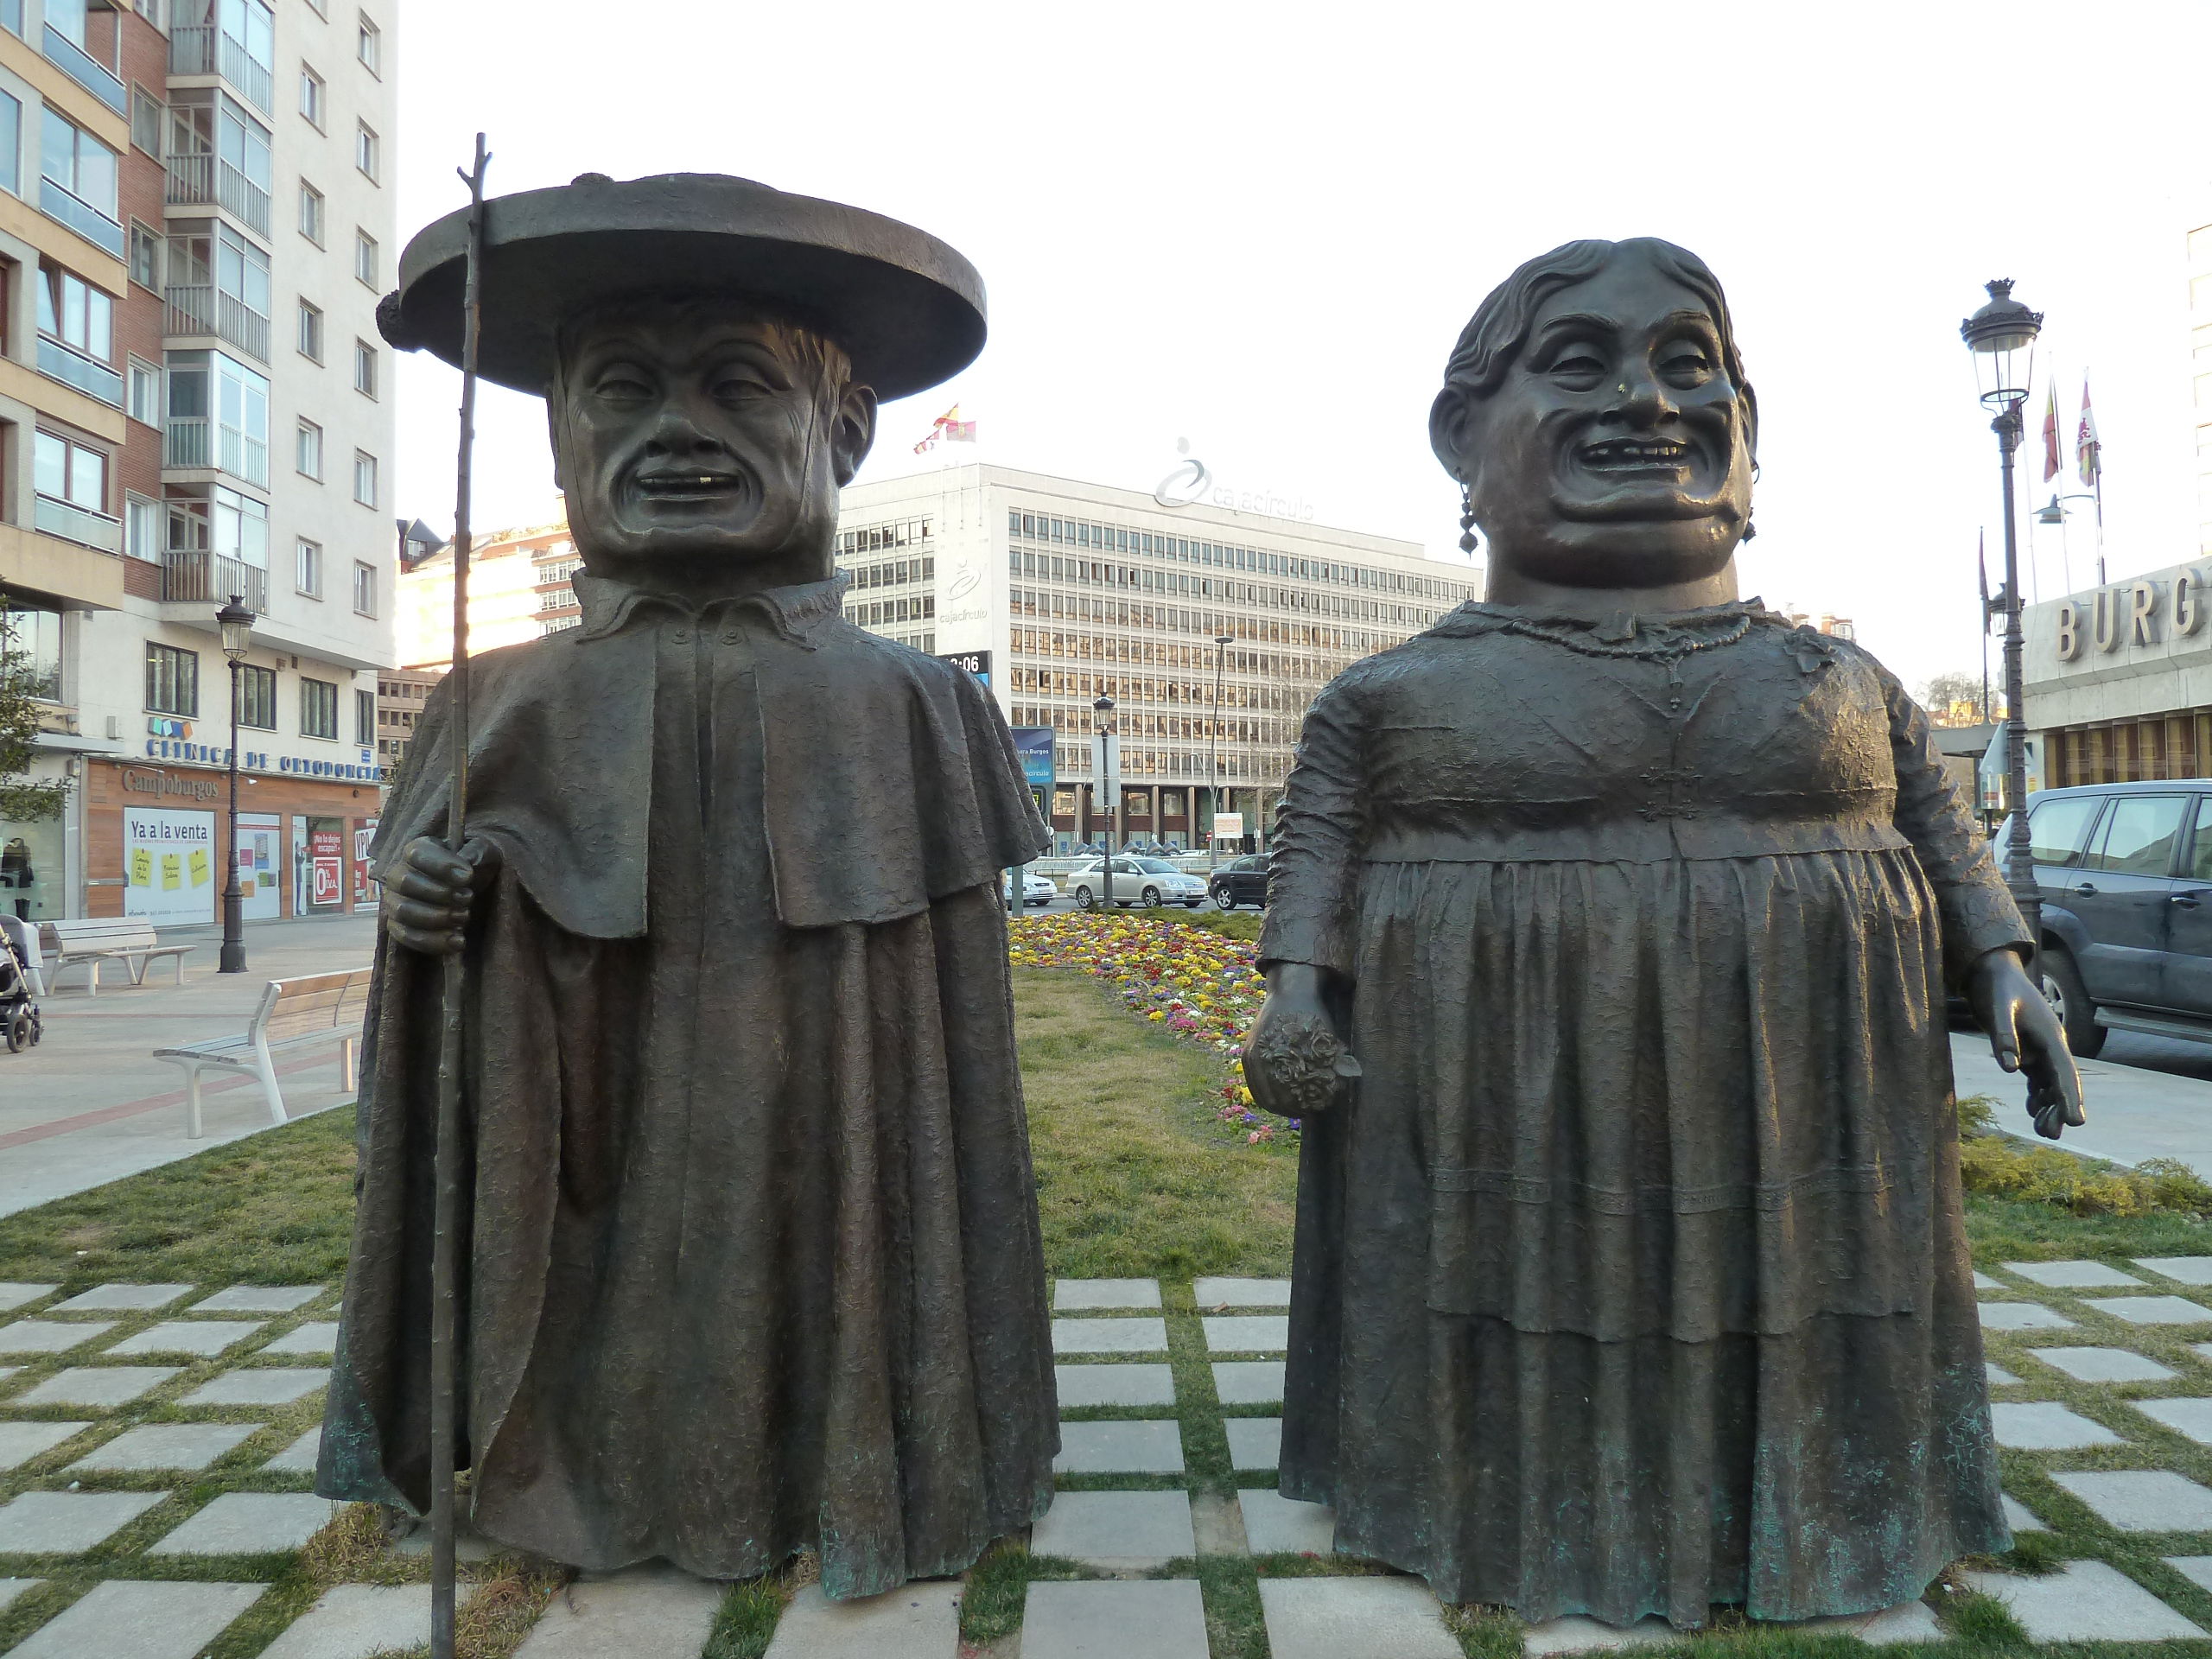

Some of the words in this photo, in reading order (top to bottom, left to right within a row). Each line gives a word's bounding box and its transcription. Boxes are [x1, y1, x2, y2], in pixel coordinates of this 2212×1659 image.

[939, 608, 988, 625] cajacírculo
[247, 751, 269, 768] DE
[280, 755, 382, 781] ORTODONCIA
[123, 769, 219, 801] Campoburgos
[131, 820, 146, 838] Ya
[149, 823, 157, 838] a
[161, 820, 171, 839] la
[175, 823, 207, 840] venta
